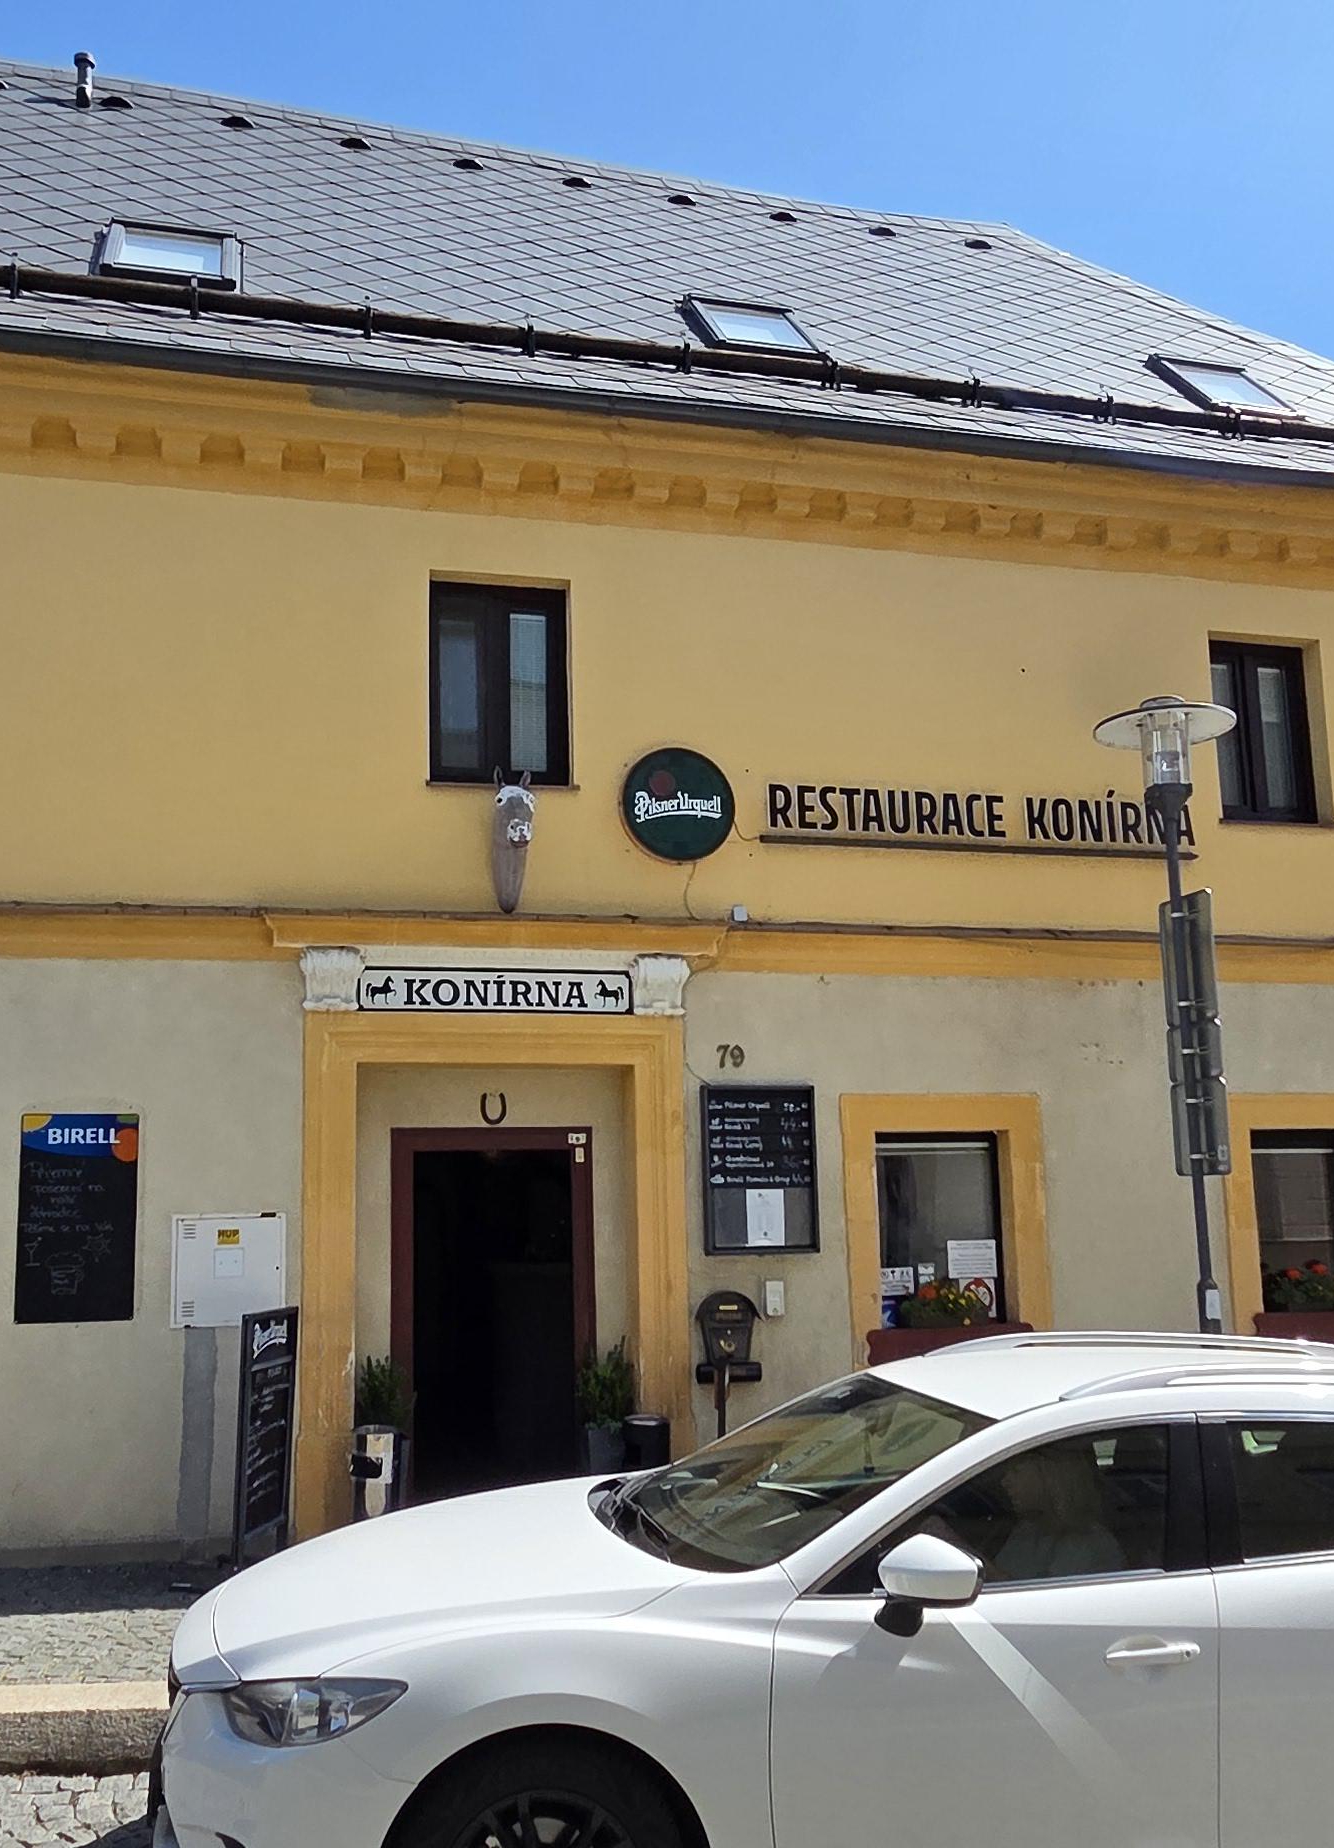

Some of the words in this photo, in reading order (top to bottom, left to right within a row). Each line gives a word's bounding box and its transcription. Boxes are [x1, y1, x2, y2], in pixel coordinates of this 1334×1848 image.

[634, 791, 679, 823] Pilsner
[677, 791, 722, 818] Urquell
[768, 783, 1006, 838] RESTAURACE
[404, 974, 588, 1008] KONÍRNA
[716, 1044, 745, 1069] 79
[47, 1128, 120, 1145] BIRELL
